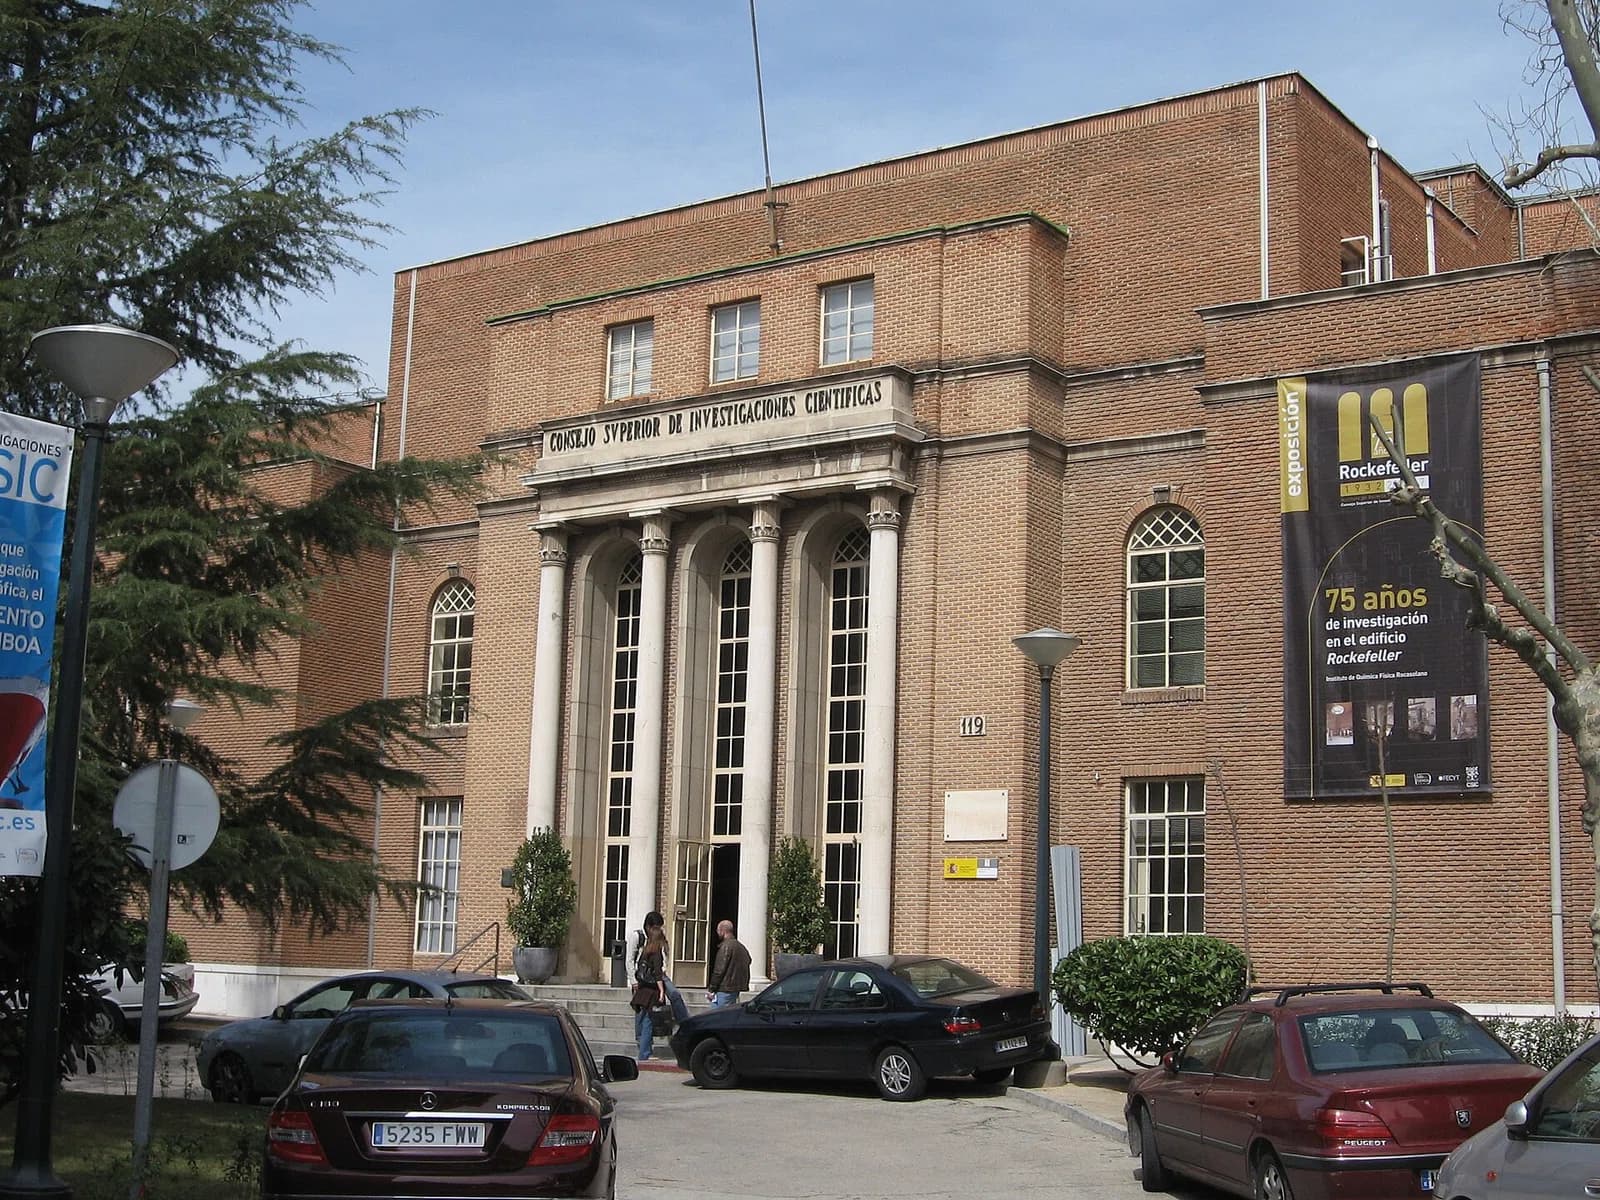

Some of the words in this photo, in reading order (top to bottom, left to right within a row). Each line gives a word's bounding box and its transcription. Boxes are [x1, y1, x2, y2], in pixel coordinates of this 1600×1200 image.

[550, 428, 596, 452] CONSEJO
[603, 418, 660, 444] SVPERIOR
[668, 413, 683, 435] DE
[689, 395, 796, 432] INVESTIGACIONES
[805, 381, 882, 414] CIENTIFICAS
[1282, 391, 1304, 497] exposición
[1340, 458, 1429, 480] Rockefeler
[1, 543, 24, 557] que
[31, 586, 43, 601] el
[1325, 587, 1356, 613] 75
[1363, 583, 1428, 611] años
[1325, 618, 1340, 631] de
[1343, 610, 1428, 630] investigación
[1326, 637, 1341, 648] en
[1344, 633, 1357, 647] el
[1359, 630, 1406, 645] edificio
[1326, 650, 1402, 665] Rockefeller
[961, 716, 984, 734] 119
[386, 1125, 436, 1144] 5235
[442, 1125, 479, 1145] FWW
[1344, 1139, 1387, 1147] PEUGEOT
